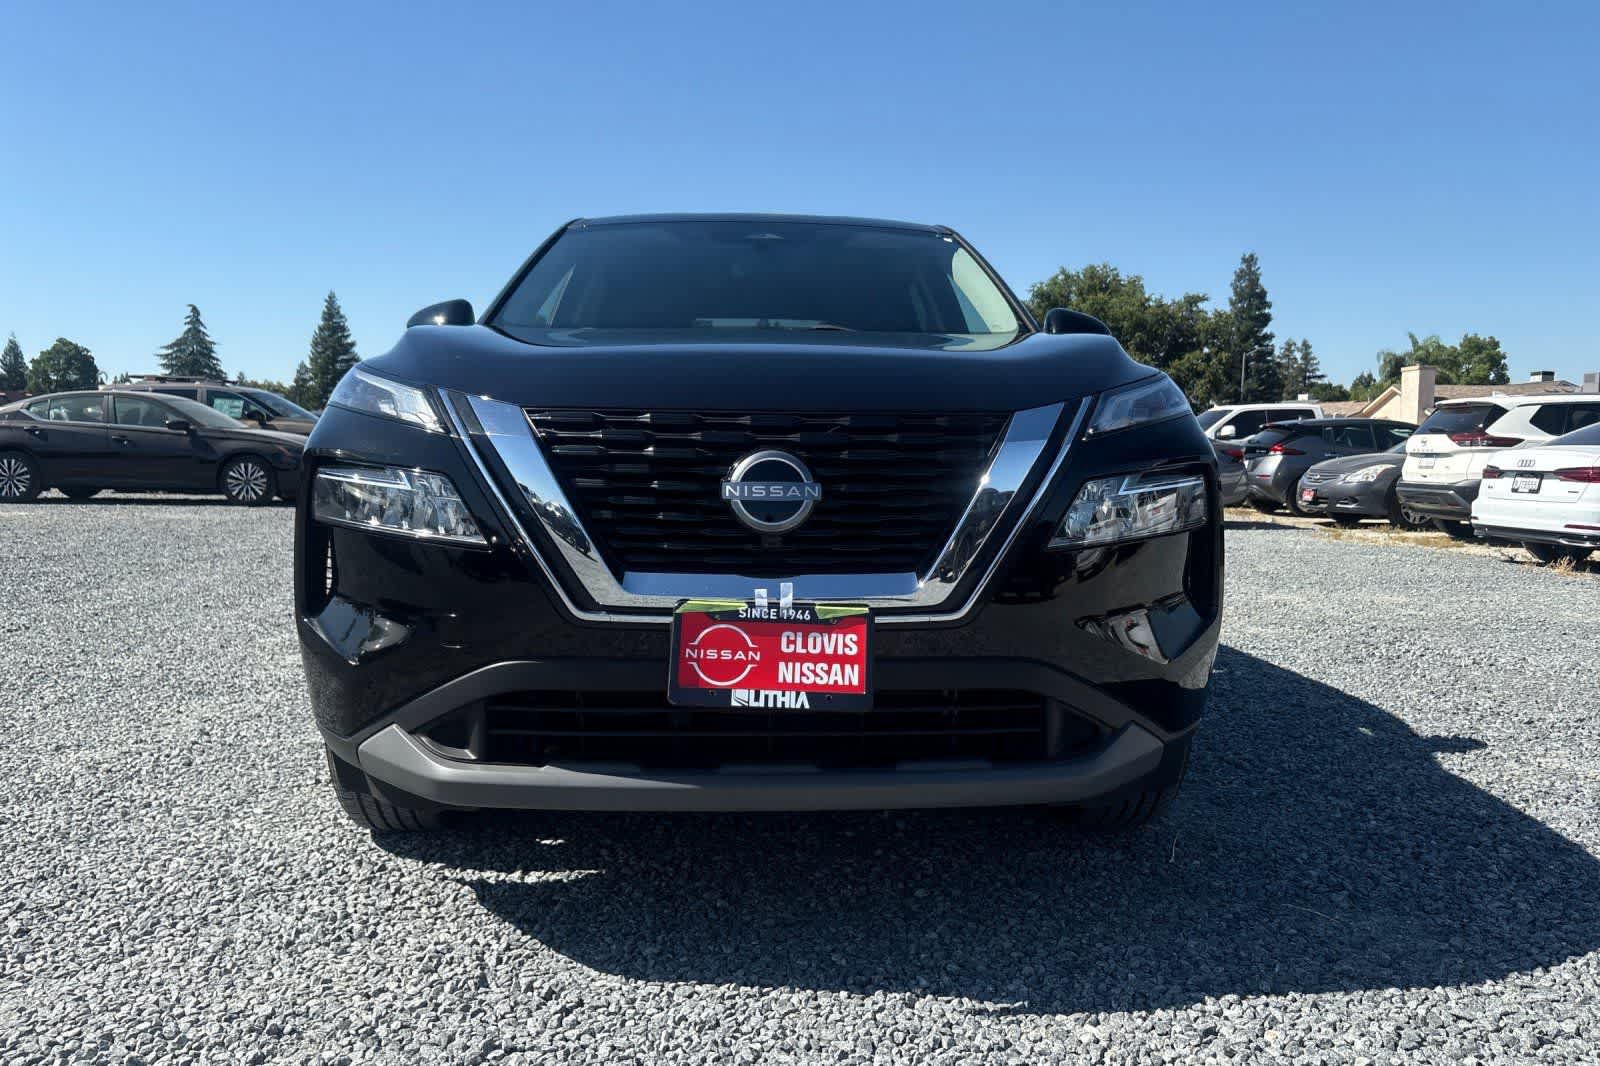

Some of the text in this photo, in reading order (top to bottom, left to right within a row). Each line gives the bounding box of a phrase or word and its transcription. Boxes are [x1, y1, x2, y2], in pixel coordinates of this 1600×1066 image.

[725, 485, 819, 497] NISSAN
[739, 608, 811, 620] SINCE 1946
[781, 631, 858, 655] CLOVIS
[685, 647, 760, 661] NISSAN
[777, 661, 859, 686] NISSAN
[749, 690, 810, 709] LITHIA
